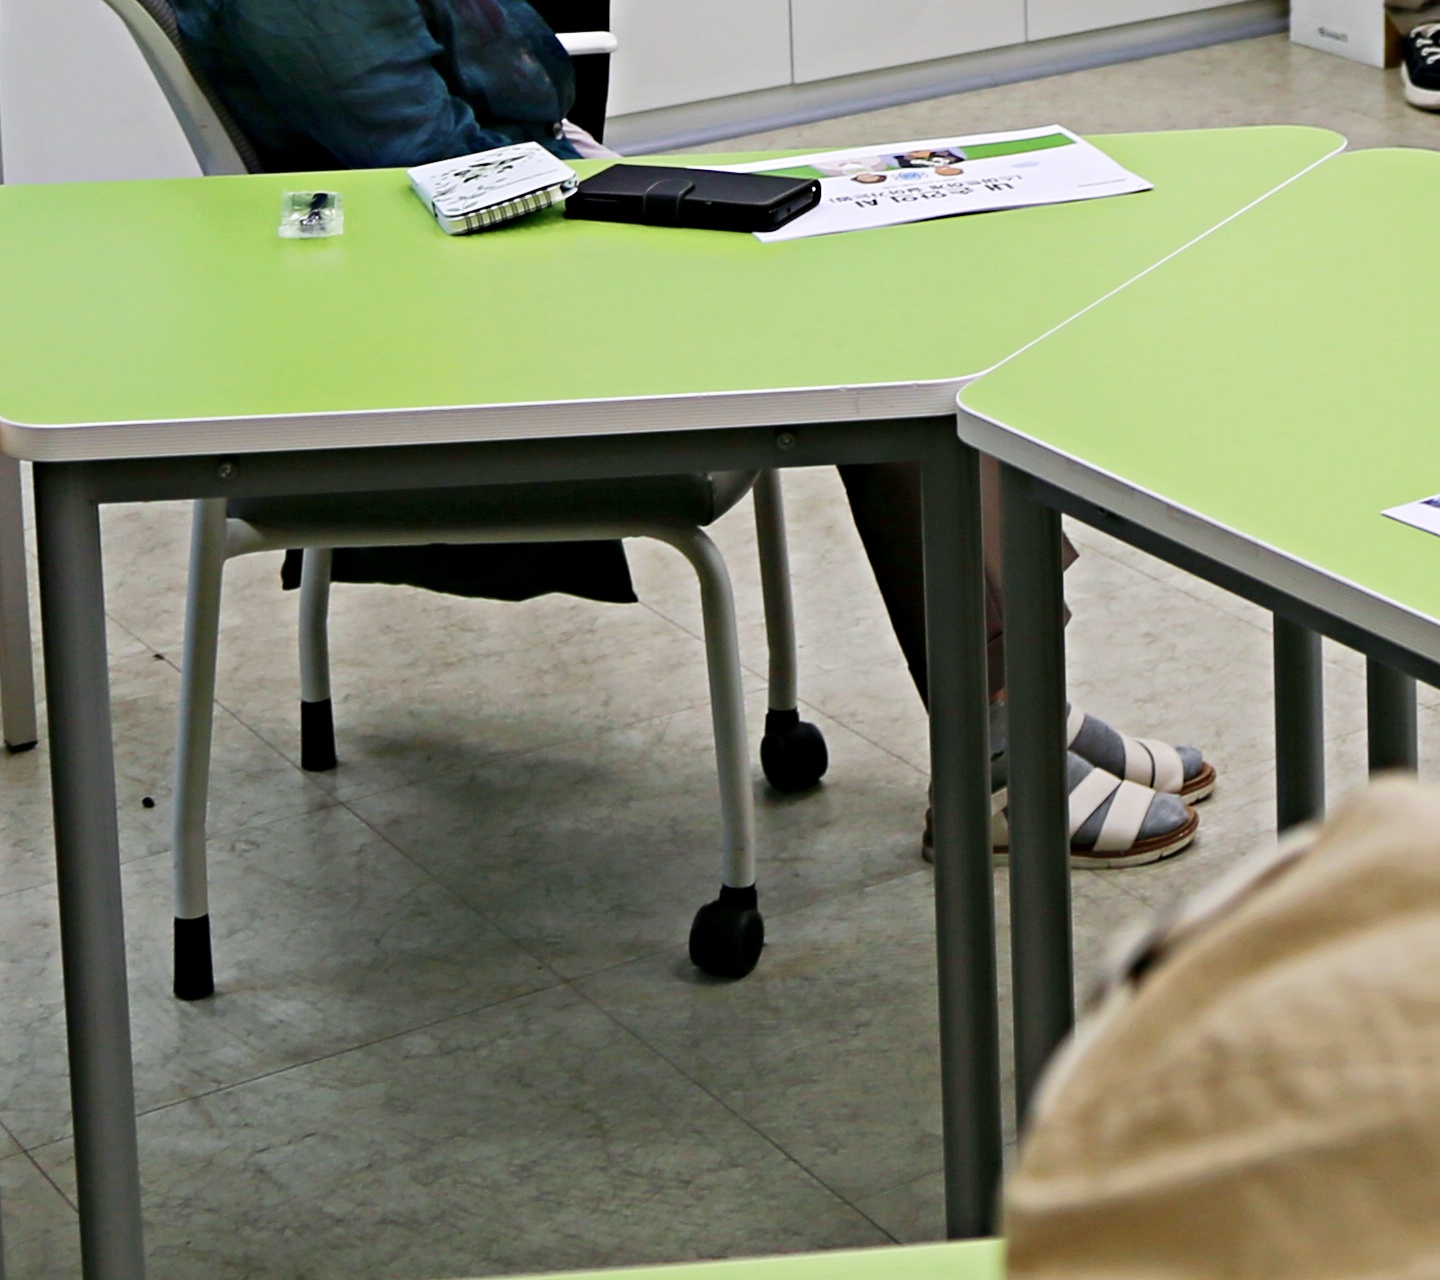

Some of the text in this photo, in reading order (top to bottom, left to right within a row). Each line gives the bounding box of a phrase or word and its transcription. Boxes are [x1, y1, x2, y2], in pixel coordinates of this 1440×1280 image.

[855, 182, 1014, 208] 내 손안의 AI
